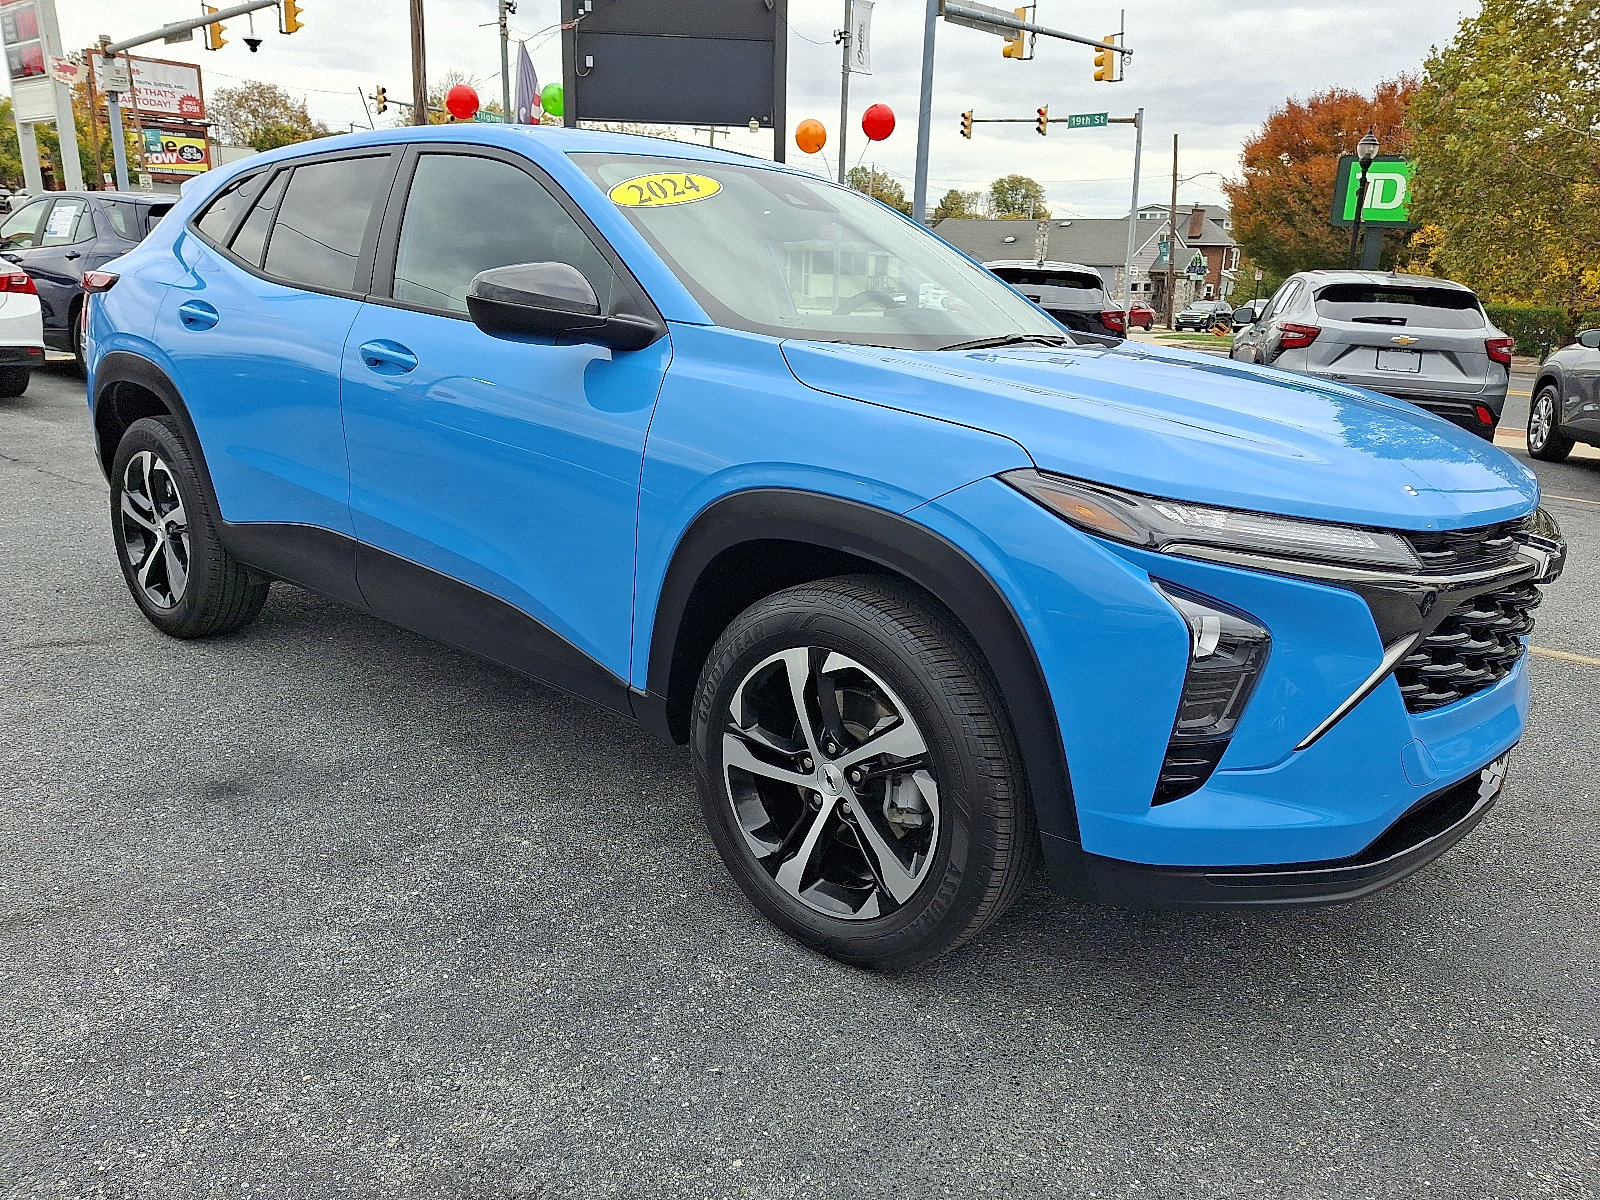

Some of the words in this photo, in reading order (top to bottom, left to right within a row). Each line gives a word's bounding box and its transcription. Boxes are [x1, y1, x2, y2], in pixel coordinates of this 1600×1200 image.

[136, 97, 171, 108] TODAY!
[143, 88, 176, 99] THAT'S
[1072, 116, 1091, 126] 19th
[1094, 115, 1104, 124] St
[627, 175, 700, 204] 2024
[1356, 172, 1407, 210] TD
[697, 620, 768, 724] GOODYEAR
